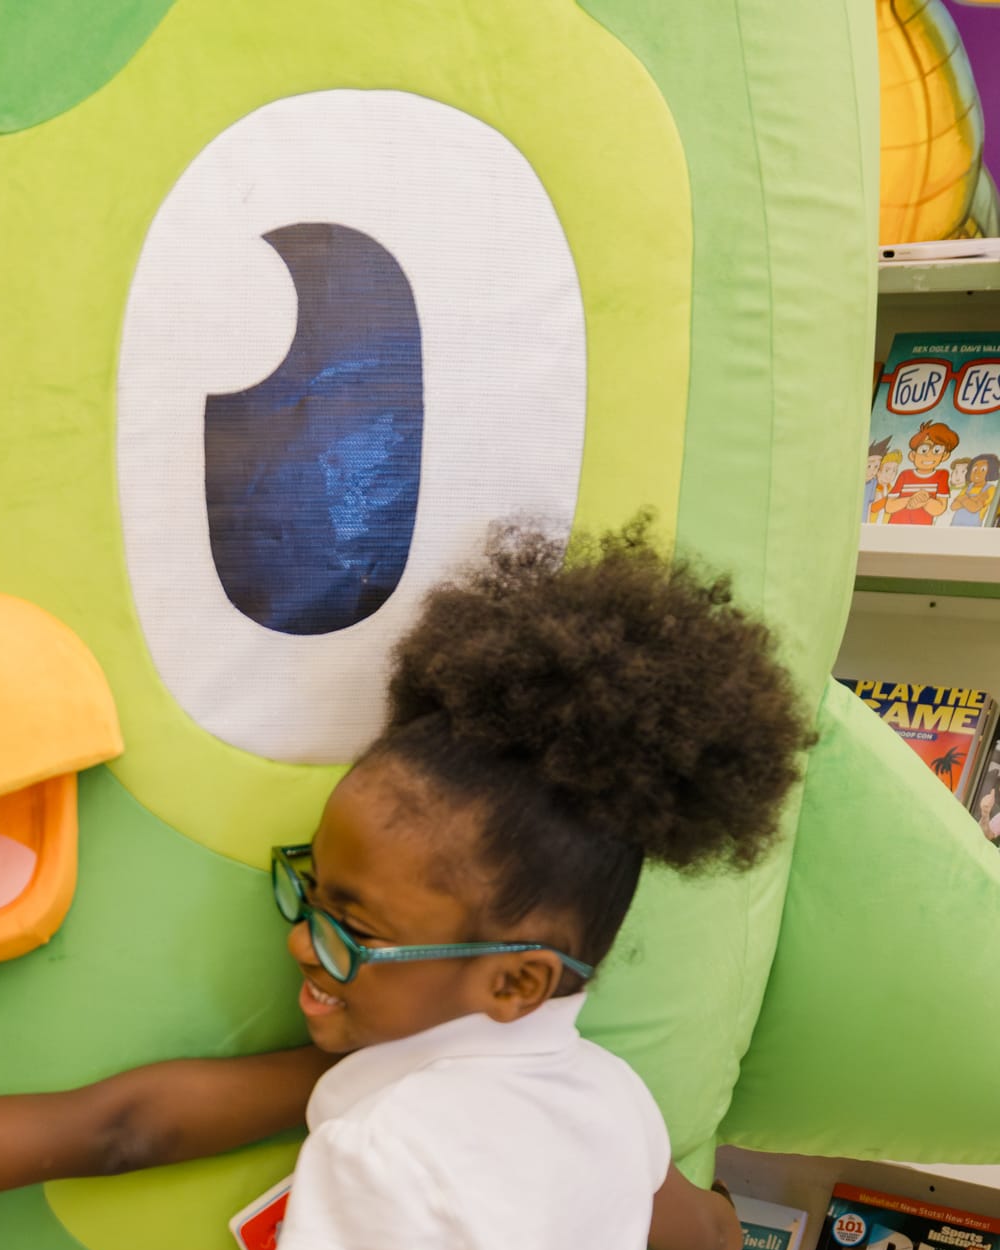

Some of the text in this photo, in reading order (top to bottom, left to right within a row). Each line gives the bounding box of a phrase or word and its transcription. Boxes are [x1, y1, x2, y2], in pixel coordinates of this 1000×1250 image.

[895, 368, 942, 406] FOUR
[855, 680, 986, 709] PLAY THE
[901, 1203, 918, 1214] New
[945, 1212, 964, 1223] New
[836, 1219, 863, 1233] 101
[941, 1225, 984, 1243] Sports
